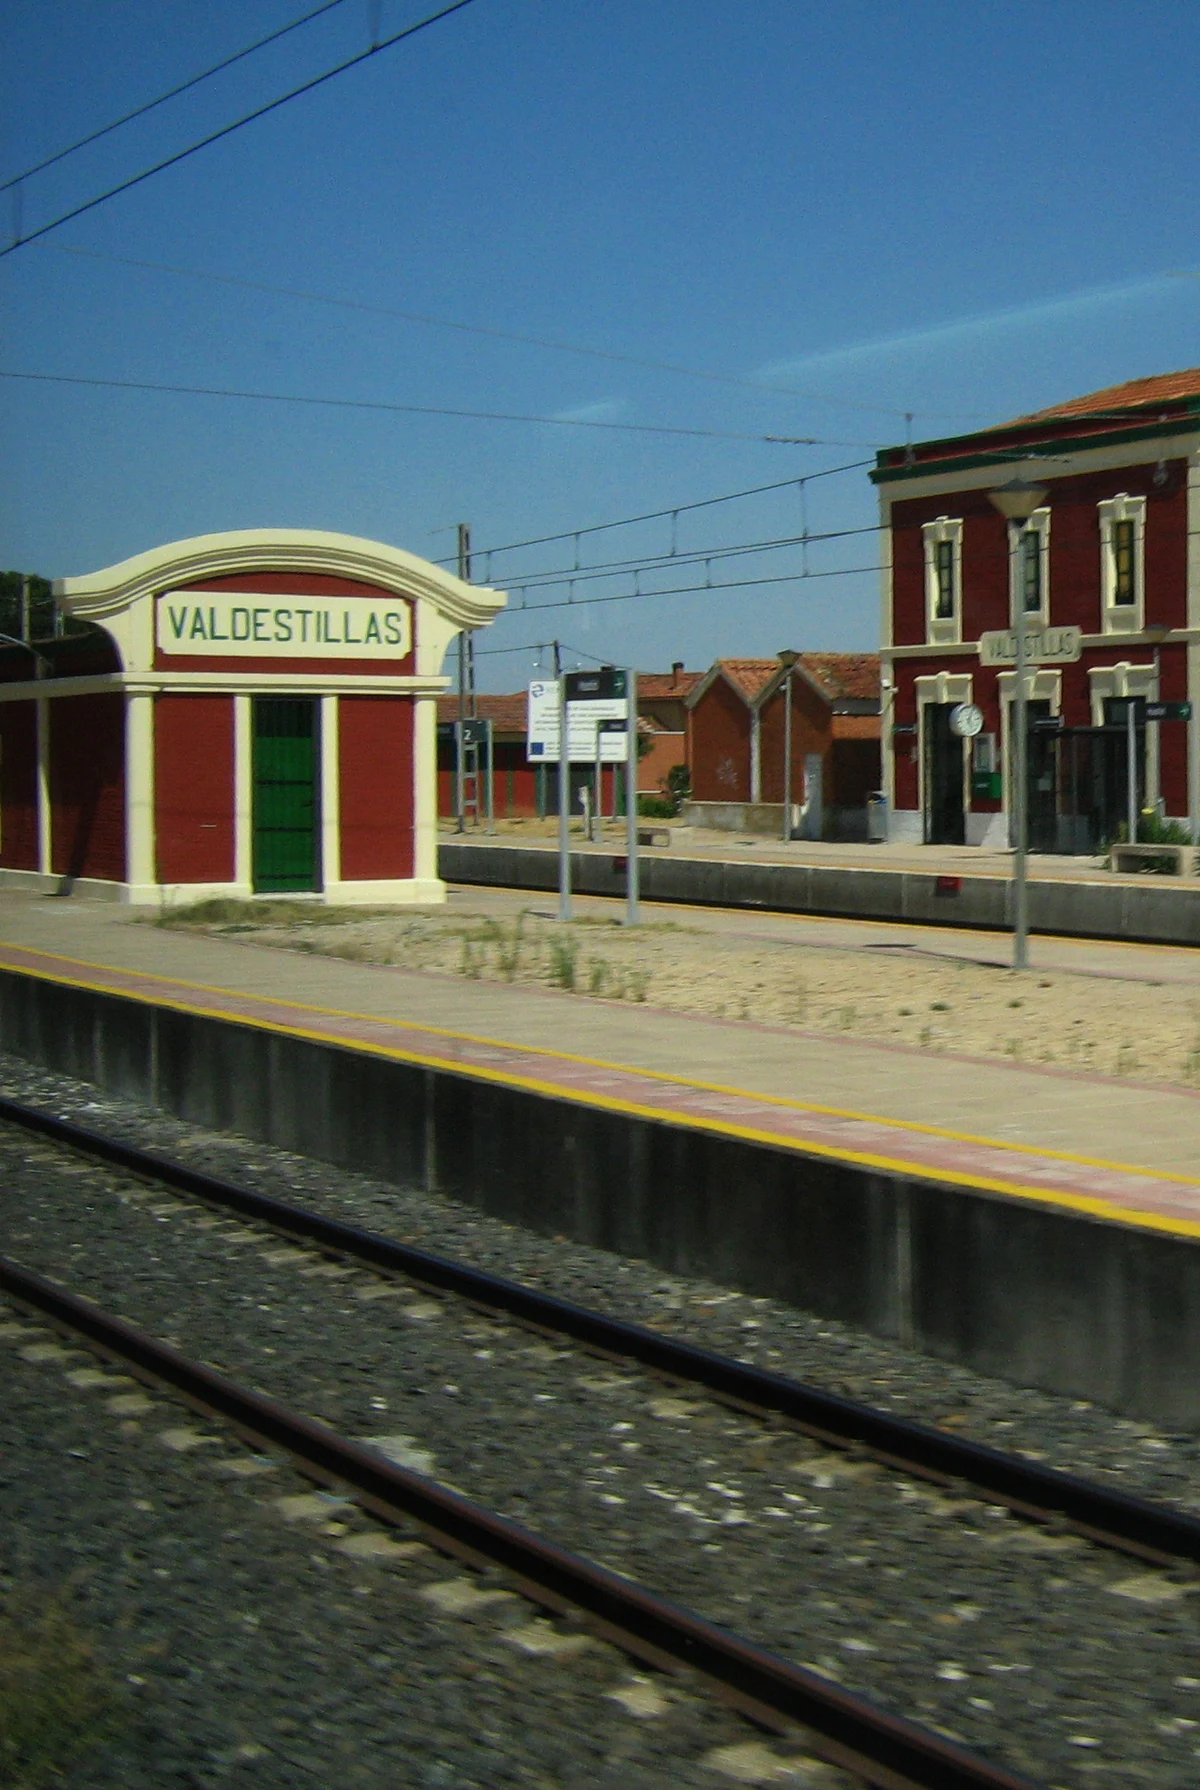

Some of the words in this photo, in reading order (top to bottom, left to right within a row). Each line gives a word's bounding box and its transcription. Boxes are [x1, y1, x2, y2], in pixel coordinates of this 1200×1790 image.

[168, 606, 402, 645] VALDESTILLAS
[988, 632, 1074, 658] VALDSTILLAS
[464, 729, 472, 741] 2
